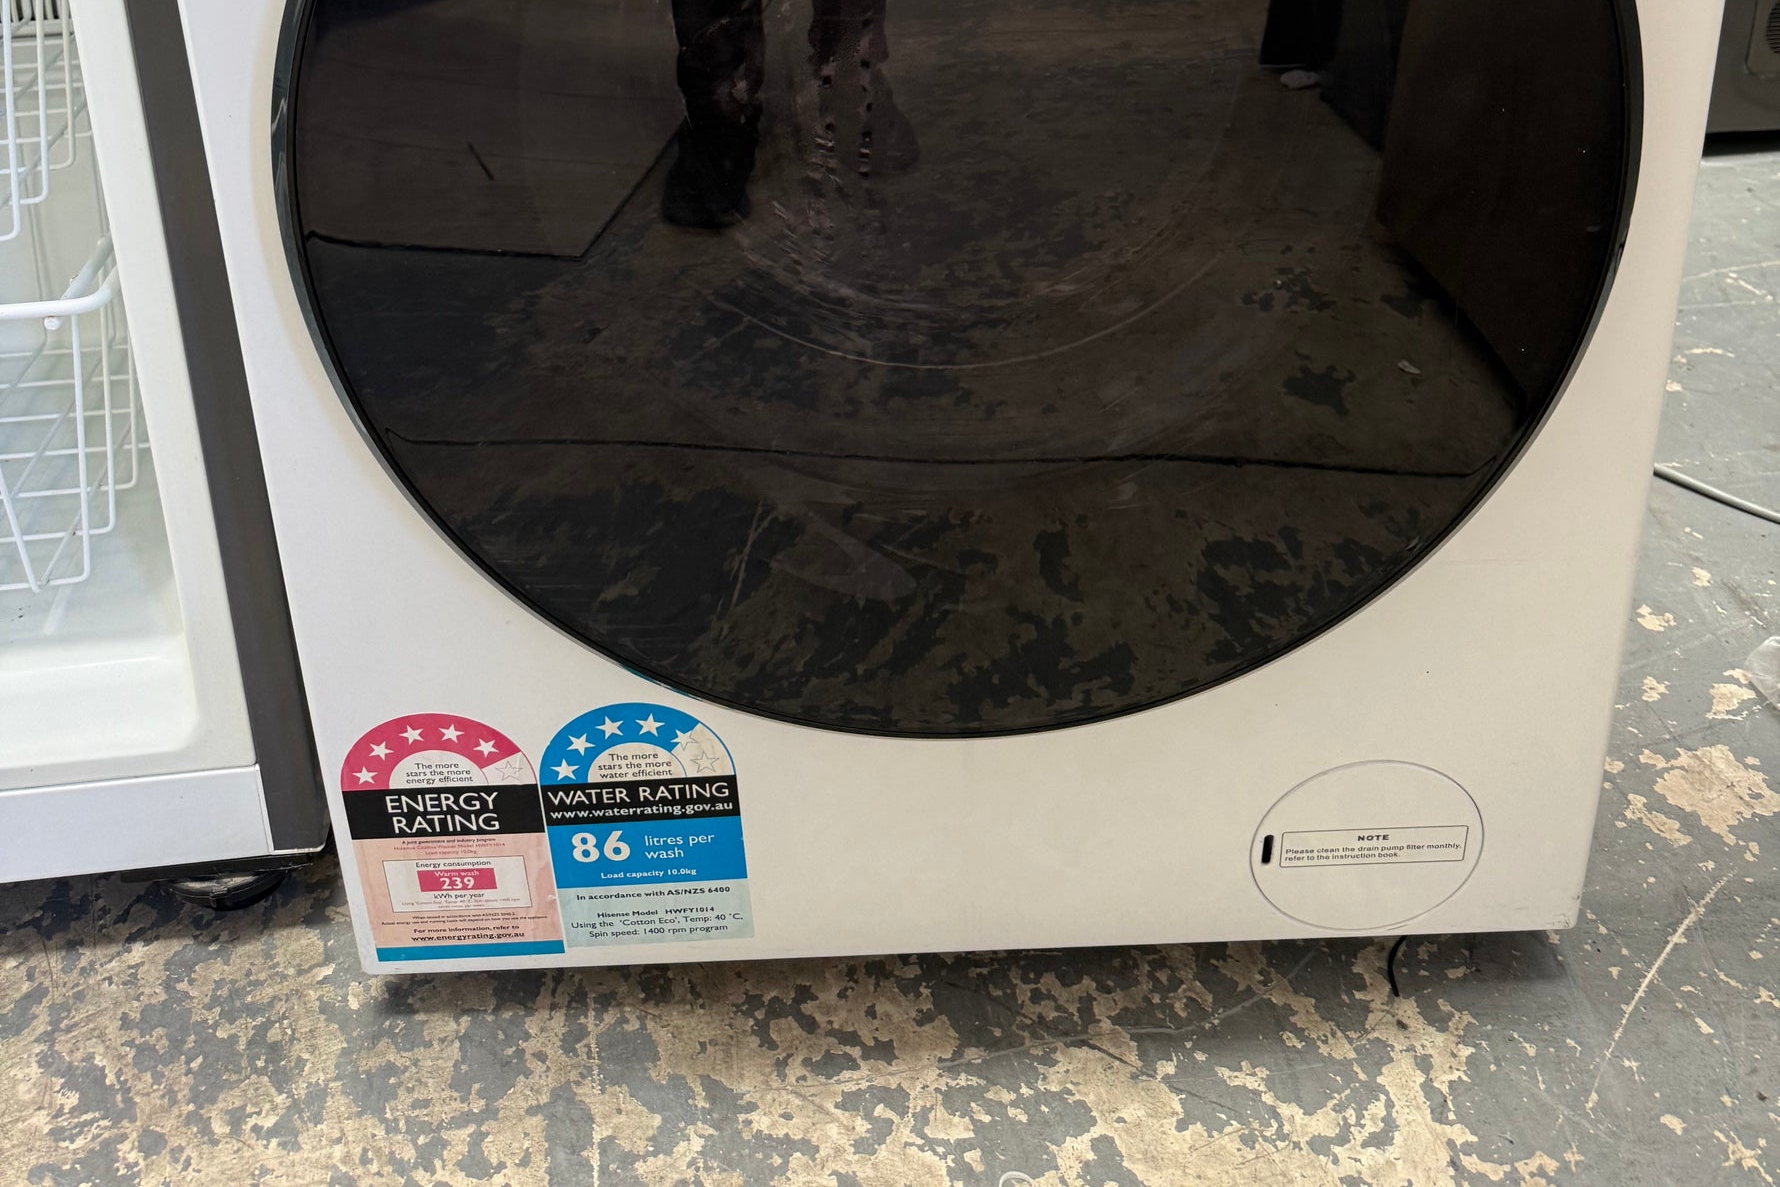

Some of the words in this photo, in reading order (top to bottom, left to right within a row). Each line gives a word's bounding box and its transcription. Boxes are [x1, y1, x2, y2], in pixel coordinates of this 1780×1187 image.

[600, 771, 629, 779] water
[632, 769, 672, 777] efficient
[548, 787, 630, 806] WATER
[639, 782, 729, 802] RATING
[385, 792, 498, 813] ENERGY
[551, 802, 733, 819] www.waterrating.gov.au
[392, 813, 500, 833] RATING
[572, 831, 630, 863] 86
[645, 835, 683, 846] litres
[689, 834, 714, 846] per
[1286, 847, 1314, 855] Please
[645, 848, 684, 859] wash
[442, 860, 491, 868] consumption
[626, 870, 664, 879] capacity
[668, 868, 697, 876] 10.0kg
[440, 878, 474, 890] 239
[588, 891, 642, 900] accordance
[667, 887, 705, 896] AS/NZS
[665, 906, 714, 915] HWFY1014
[571, 922, 597, 930] Using
[599, 920, 614, 928] the
[683, 915, 711, 924] Temp:
[411, 932, 524, 942] www.energyrating.gov.au
[589, 930, 608, 938] Spin
[611, 928, 640, 937] speed:
[668, 927, 686, 935] rpm
[689, 924, 728, 933] program
